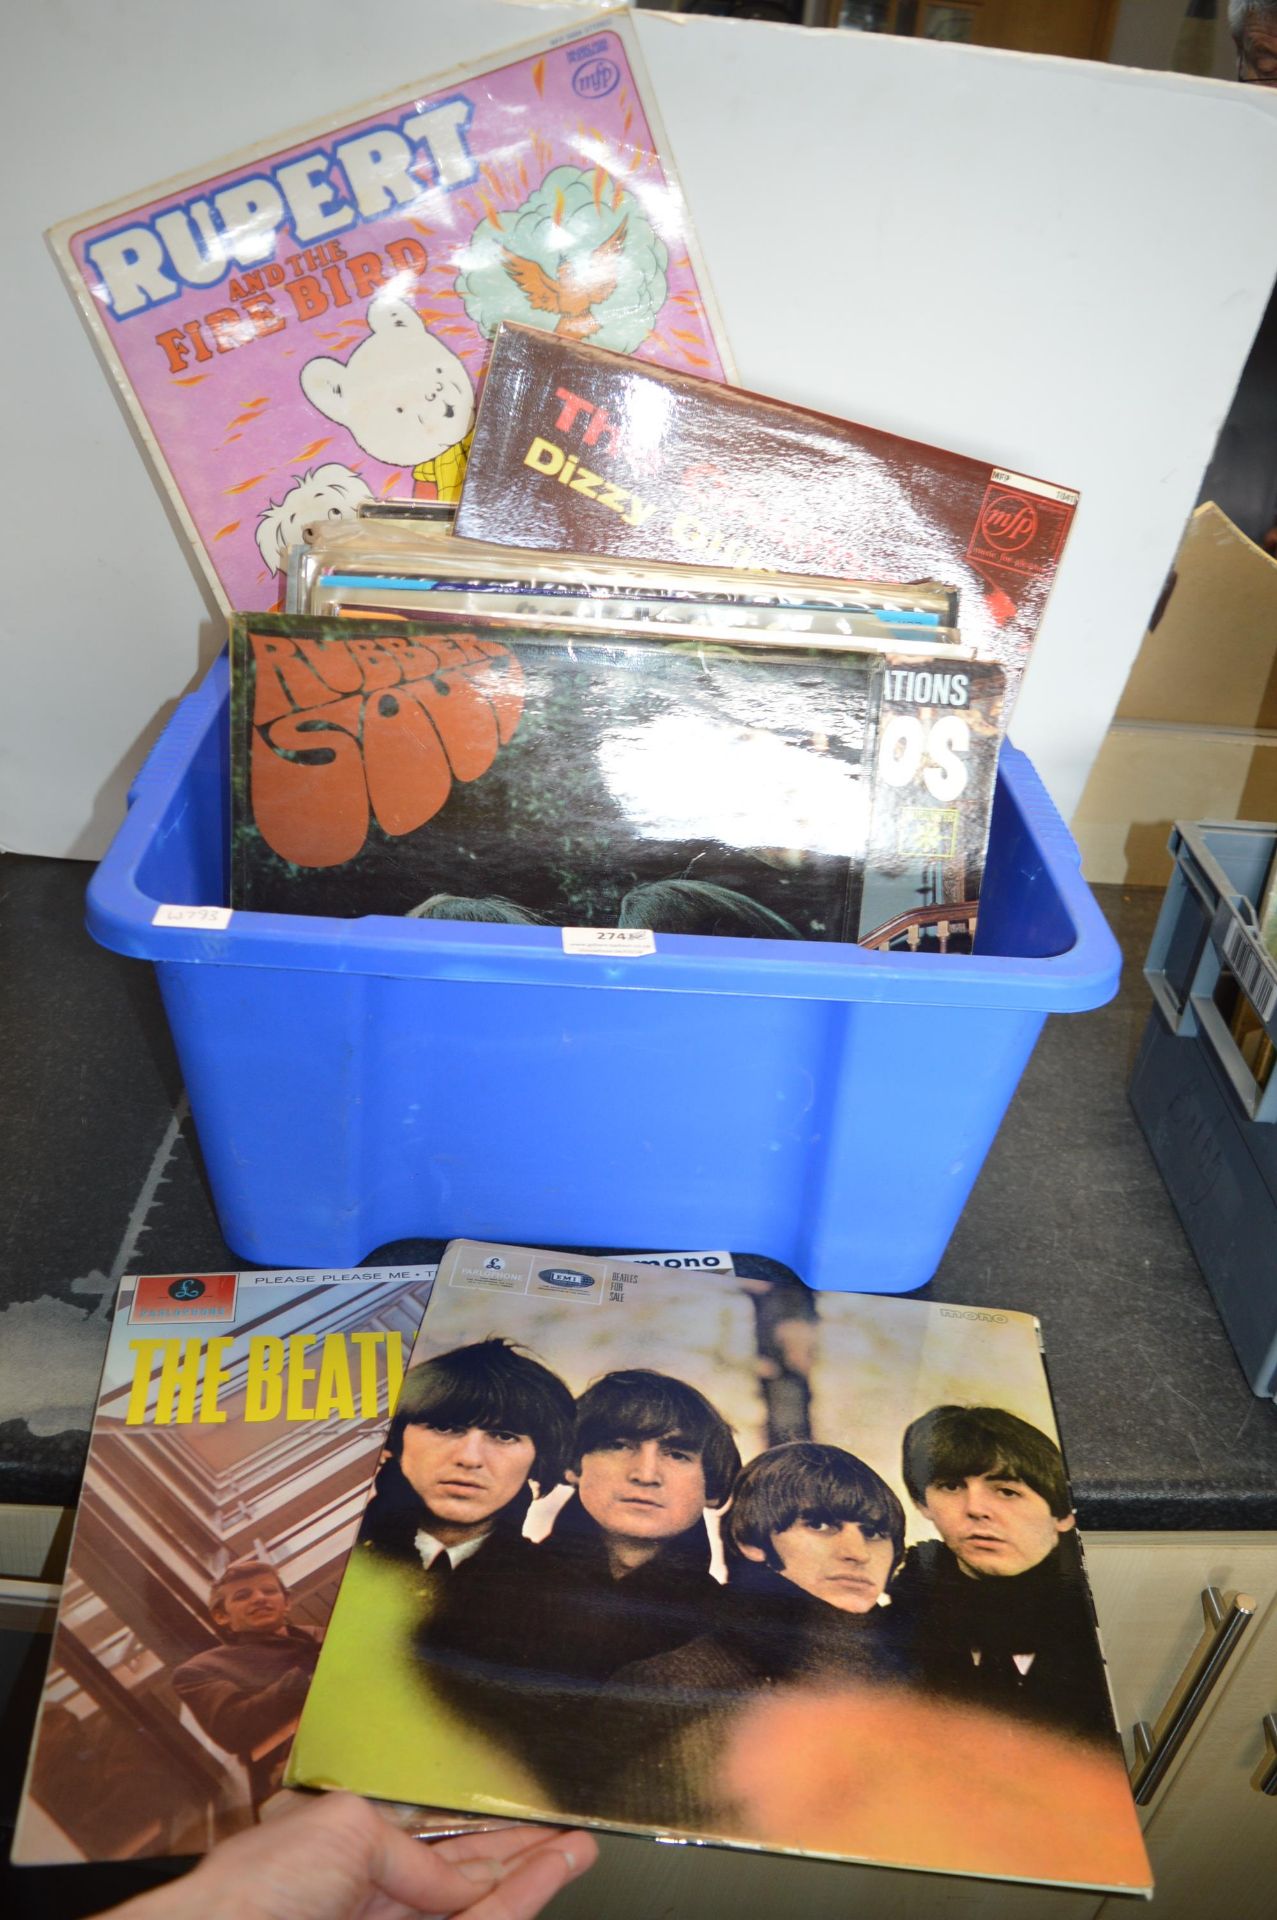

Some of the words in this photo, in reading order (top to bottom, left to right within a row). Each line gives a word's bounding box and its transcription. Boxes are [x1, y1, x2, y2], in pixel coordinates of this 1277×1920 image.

[578, 61, 613, 92] mfp
[84, 94, 479, 322] RUPERT
[229, 267, 286, 302] AND
[285, 240, 348, 278] THE
[156, 292, 287, 374] FIRE
[284, 237, 428, 322] BIRD
[523, 436, 660, 527] Dizzy
[986, 507, 1034, 539] mfp
[249, 633, 512, 736] RUBBER
[252, 655, 524, 868] SOUL
[597, 931, 648, 941] 274
[255, 1275, 315, 1285] PLEASE
[322, 1272, 382, 1282] PLEASE
[388, 1271, 411, 1280] ME
[553, 1272, 581, 1283] EMI
[610, 1282, 624, 1292] FOR
[612, 1272, 638, 1284] BEATLES
[609, 1291, 624, 1303] SALE
[940, 1308, 1008, 1324] mono
[125, 1336, 235, 1425] THE
[244, 1331, 418, 1422] BEATL
